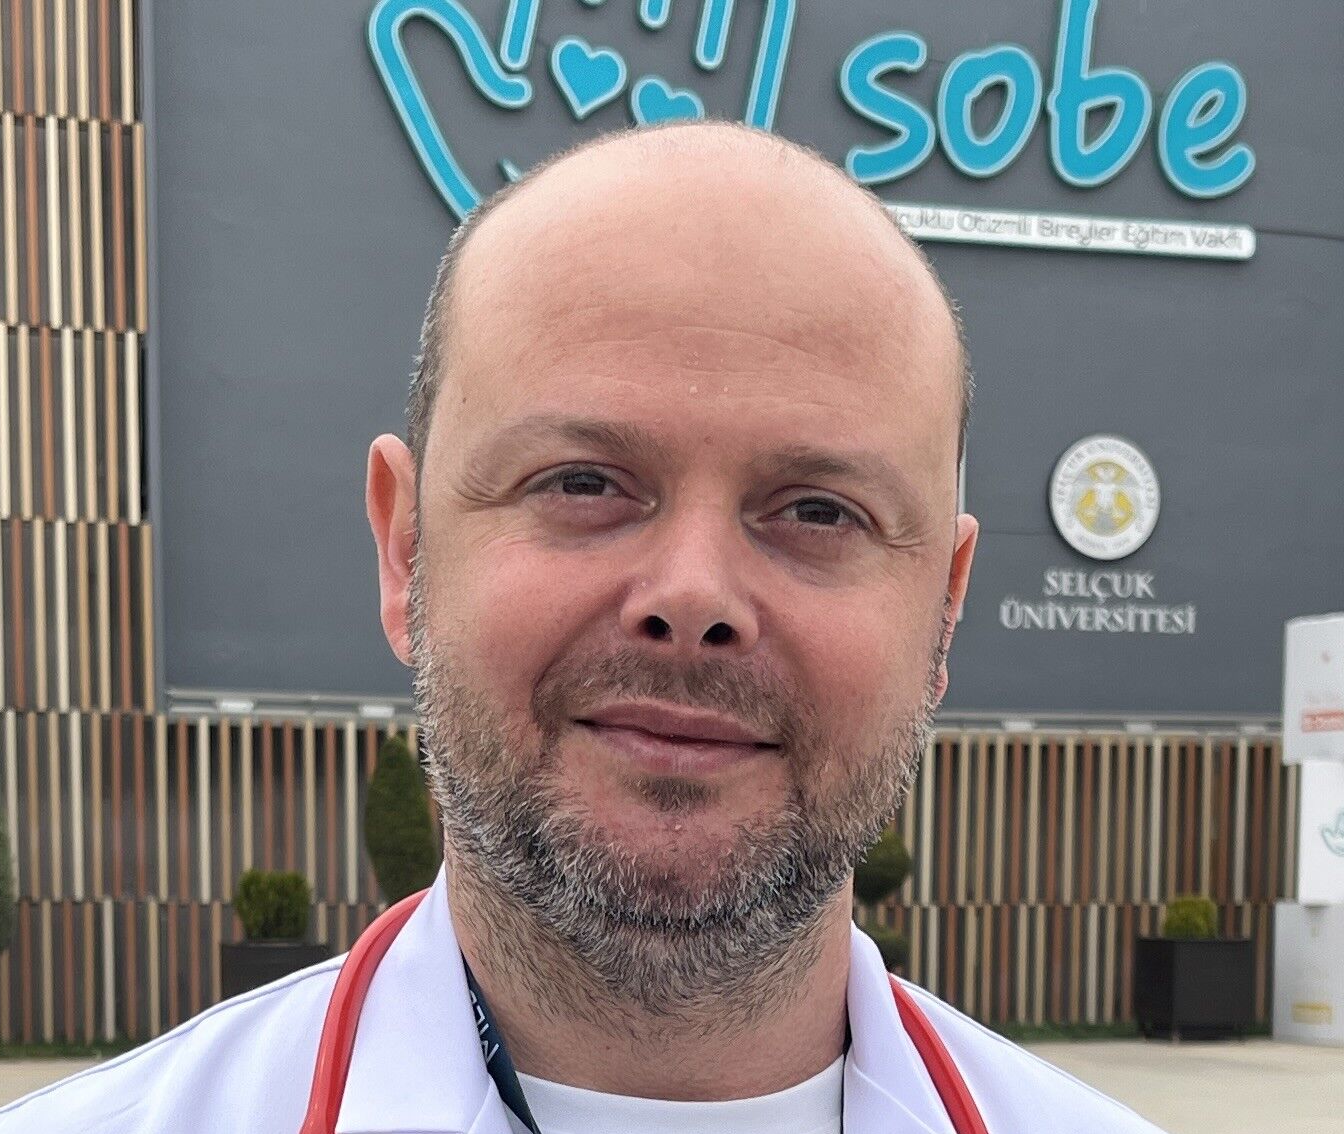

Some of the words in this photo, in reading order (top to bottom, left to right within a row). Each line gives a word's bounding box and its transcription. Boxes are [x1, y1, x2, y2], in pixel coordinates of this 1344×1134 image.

[840, 0, 1256, 199] sobe
[1043, 568, 1155, 604] SELÇUK
[1000, 598, 1197, 635] ÜNİVERSİTESİ
